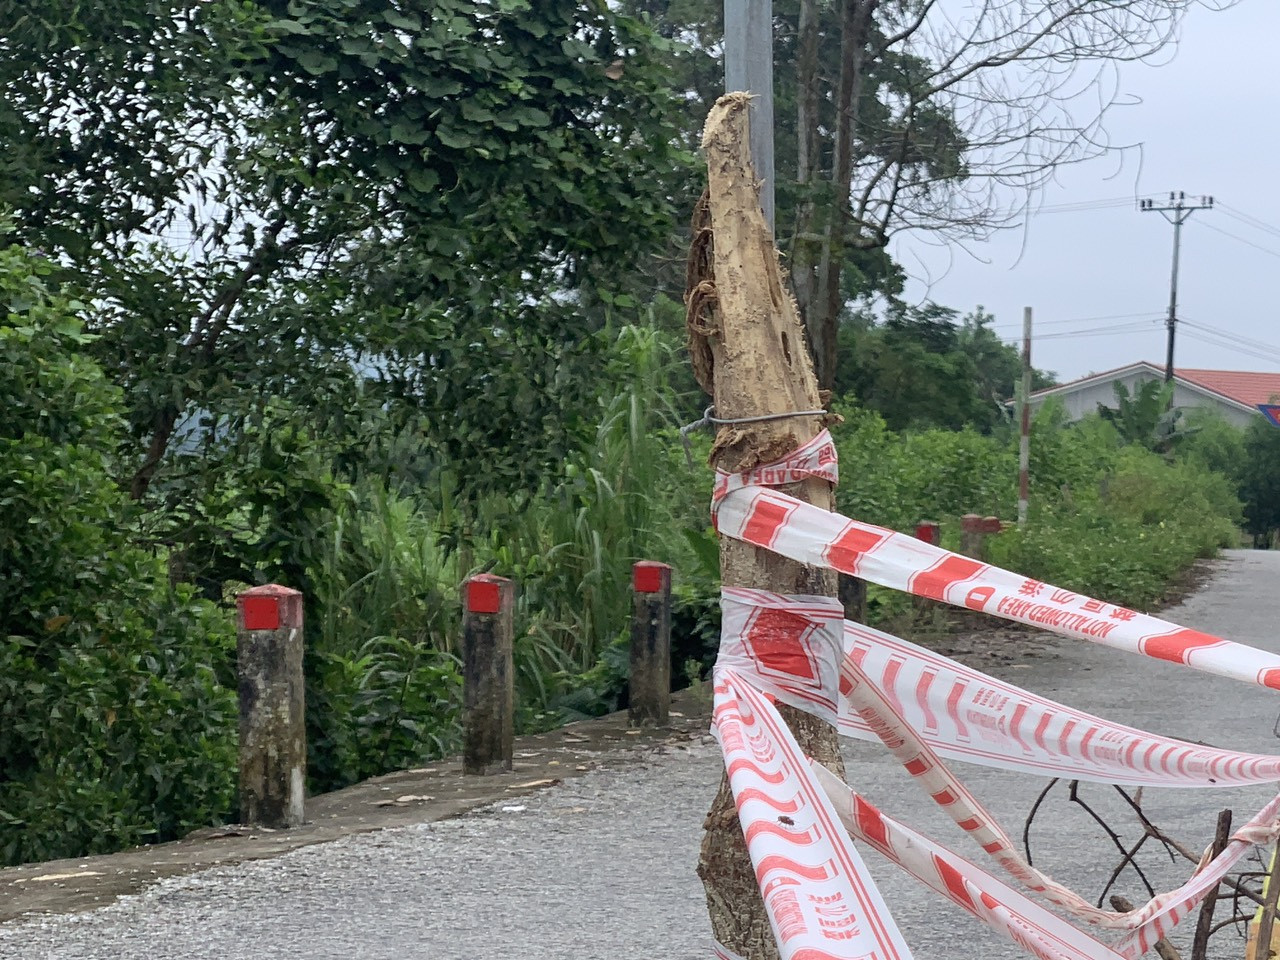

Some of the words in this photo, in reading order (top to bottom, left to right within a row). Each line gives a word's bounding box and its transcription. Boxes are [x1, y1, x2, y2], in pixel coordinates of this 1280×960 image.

[996, 594, 1033, 619] AREA
[1028, 603, 1088, 630] ALLOWED
[1082, 620, 1119, 637] NOT
